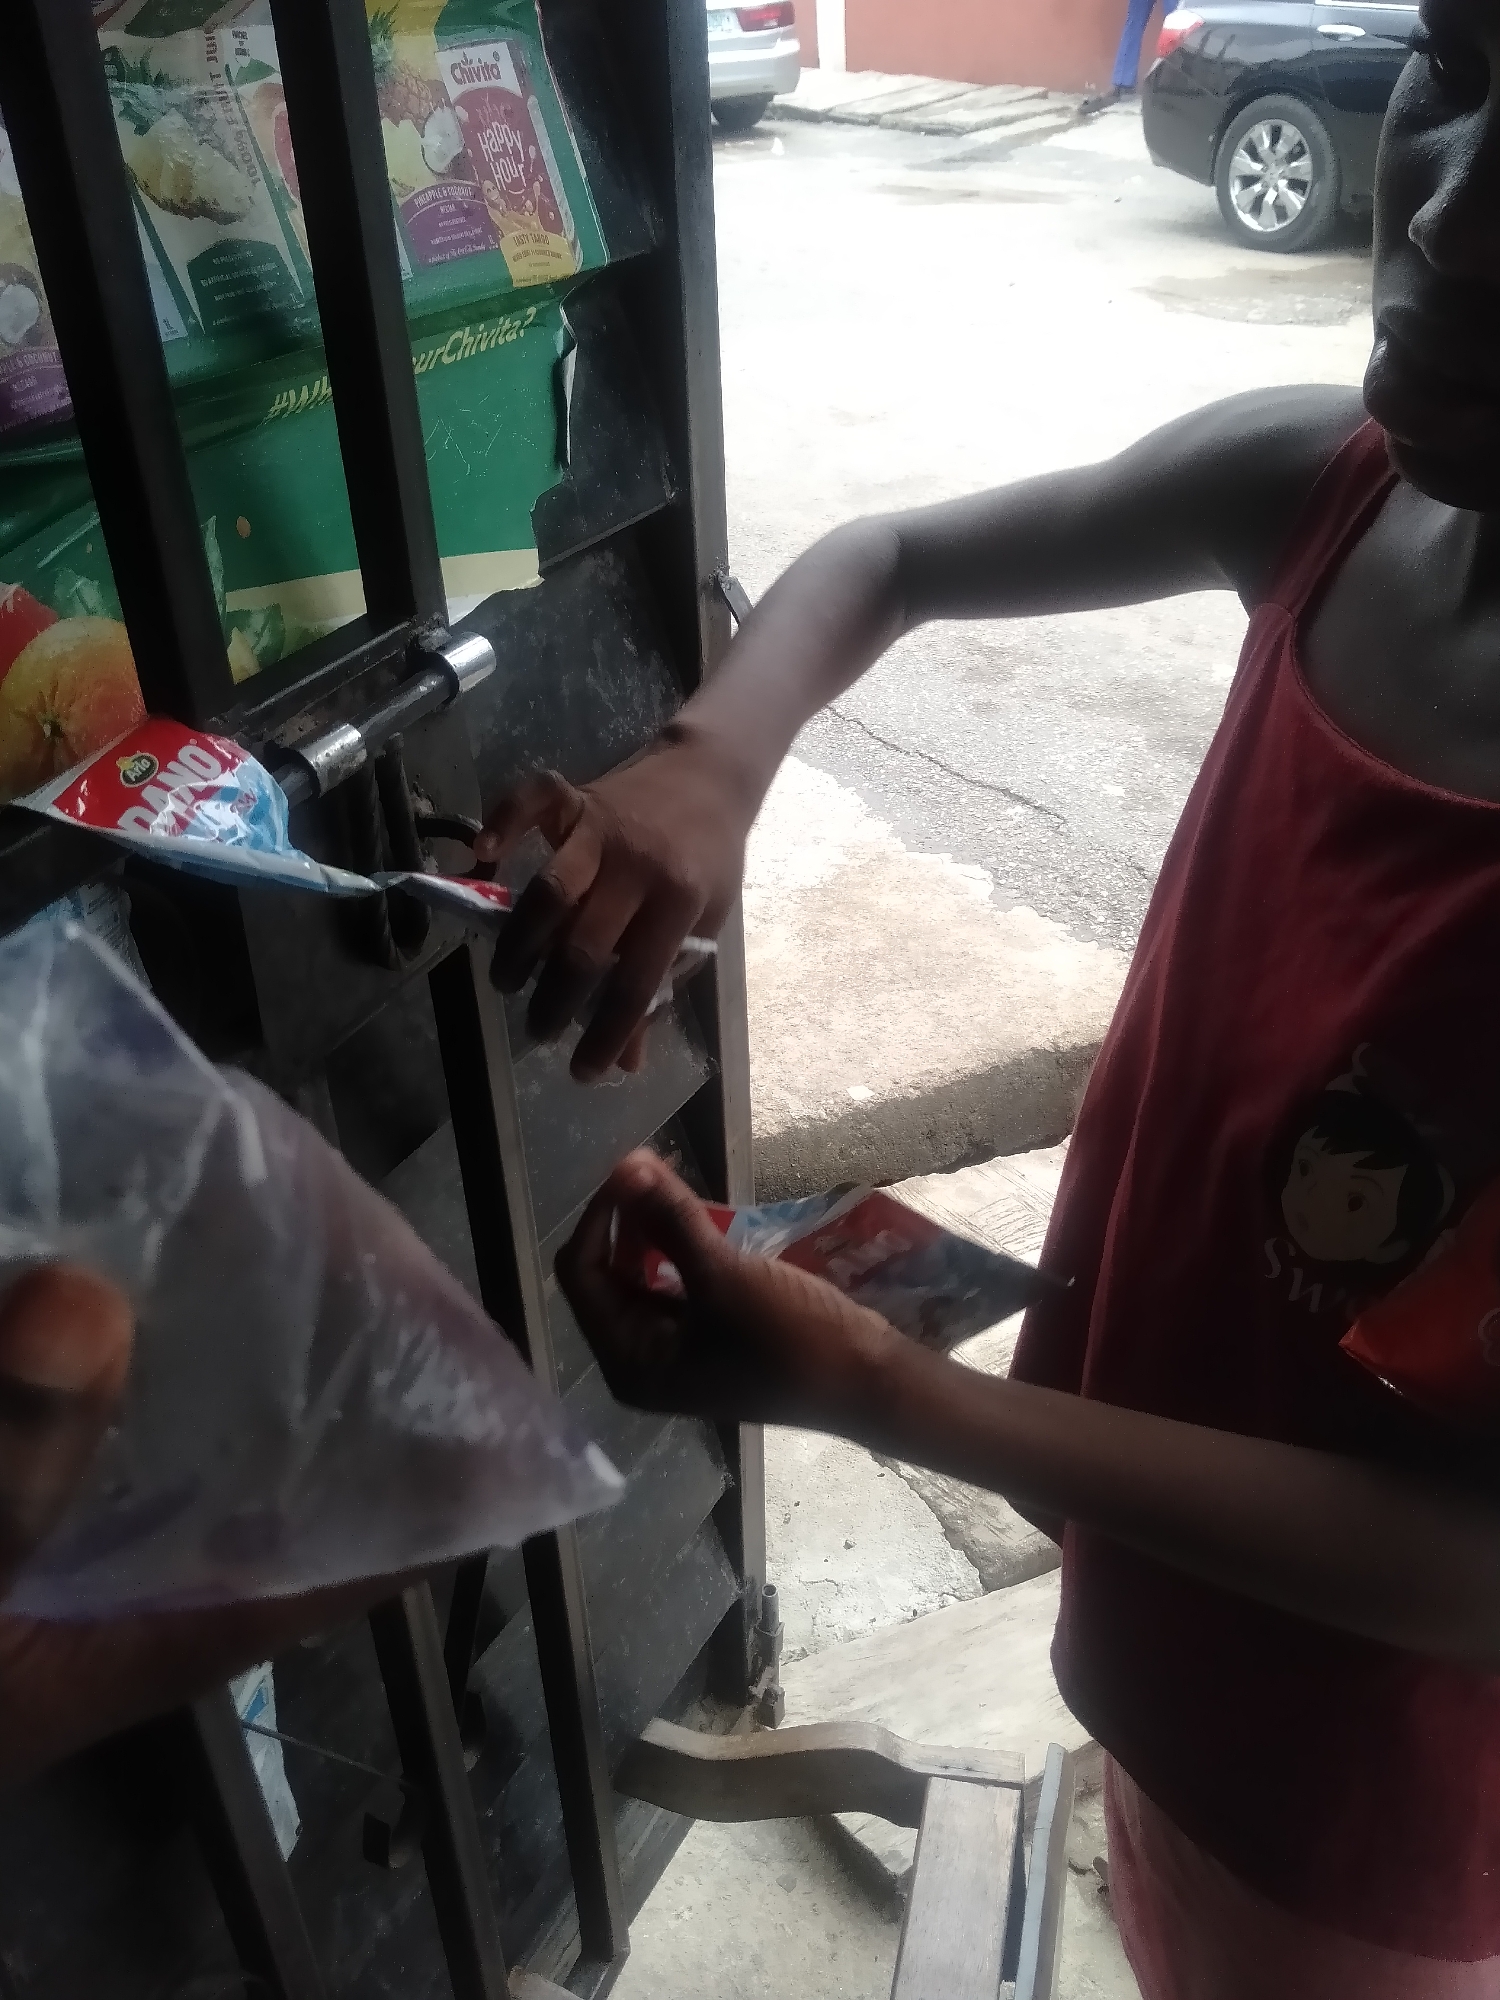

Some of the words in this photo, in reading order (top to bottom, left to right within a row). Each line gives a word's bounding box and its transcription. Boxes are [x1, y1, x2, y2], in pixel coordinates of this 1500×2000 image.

[450, 56, 501, 85] Chivita
[477, 121, 525, 162] Happy
[126, 757, 152, 782] Arla
[118, 744, 222, 832] DANO
